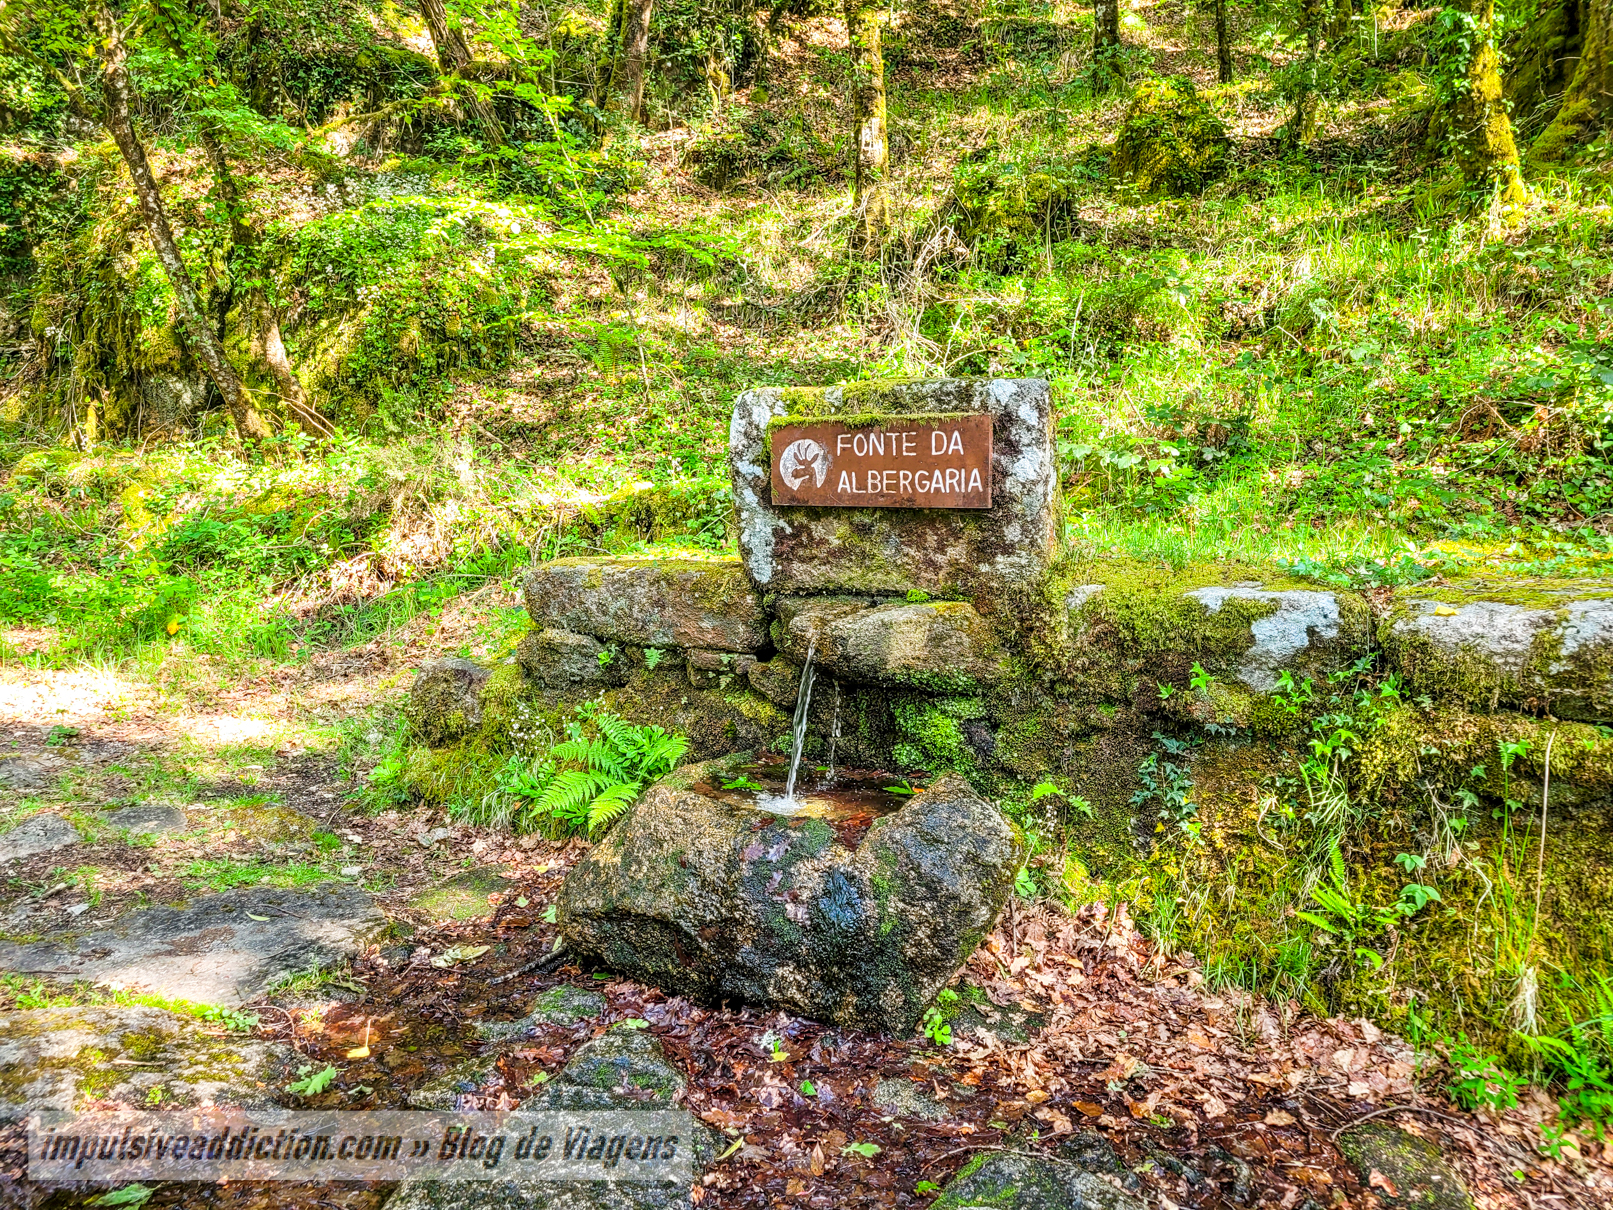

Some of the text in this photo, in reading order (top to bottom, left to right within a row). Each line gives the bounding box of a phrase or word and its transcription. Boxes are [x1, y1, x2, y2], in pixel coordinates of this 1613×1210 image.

[836, 430, 964, 457] FONTE DA
[837, 467, 983, 494] ALBERGARIA
